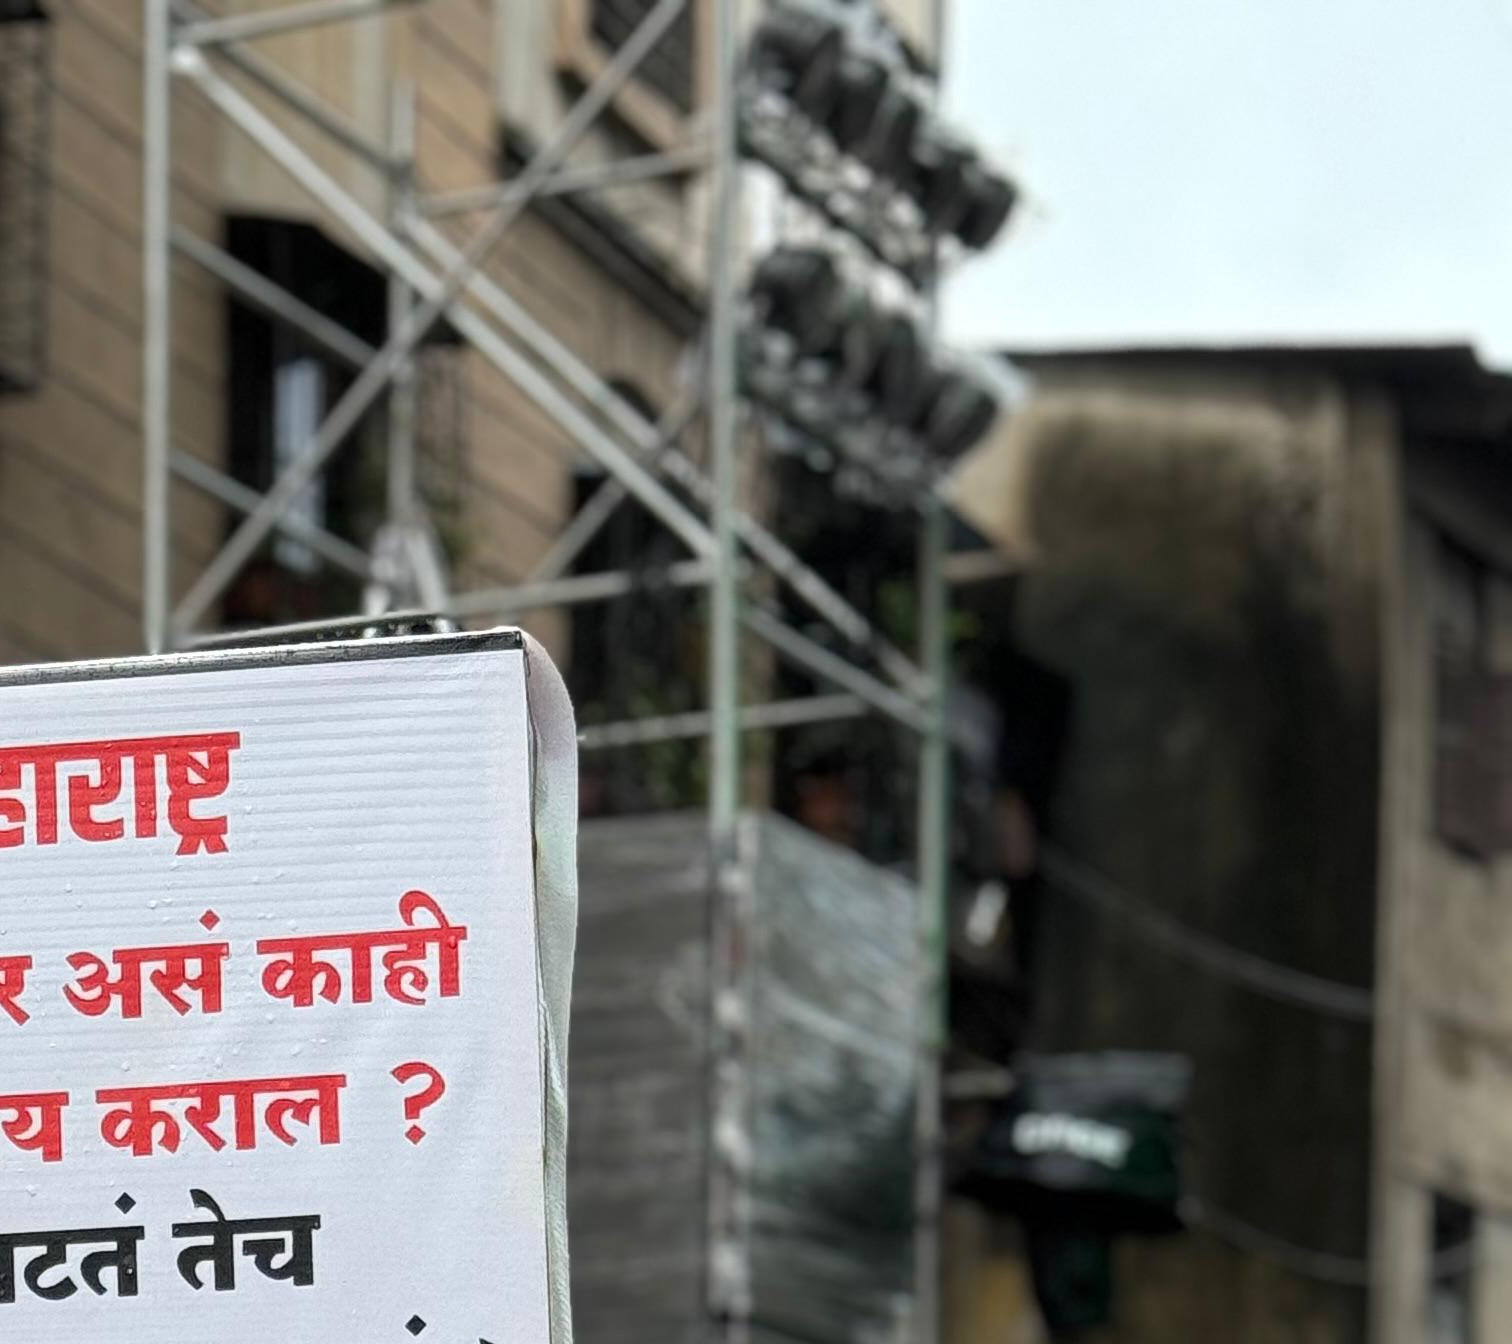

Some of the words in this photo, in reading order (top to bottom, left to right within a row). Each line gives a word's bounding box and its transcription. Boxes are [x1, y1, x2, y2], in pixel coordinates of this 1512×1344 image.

[65, 911, 229, 1018] असं
[257, 889, 467, 1008] काही
[96, 1073, 346, 1157] कराल
[171, 1188, 321, 1291] तेच
